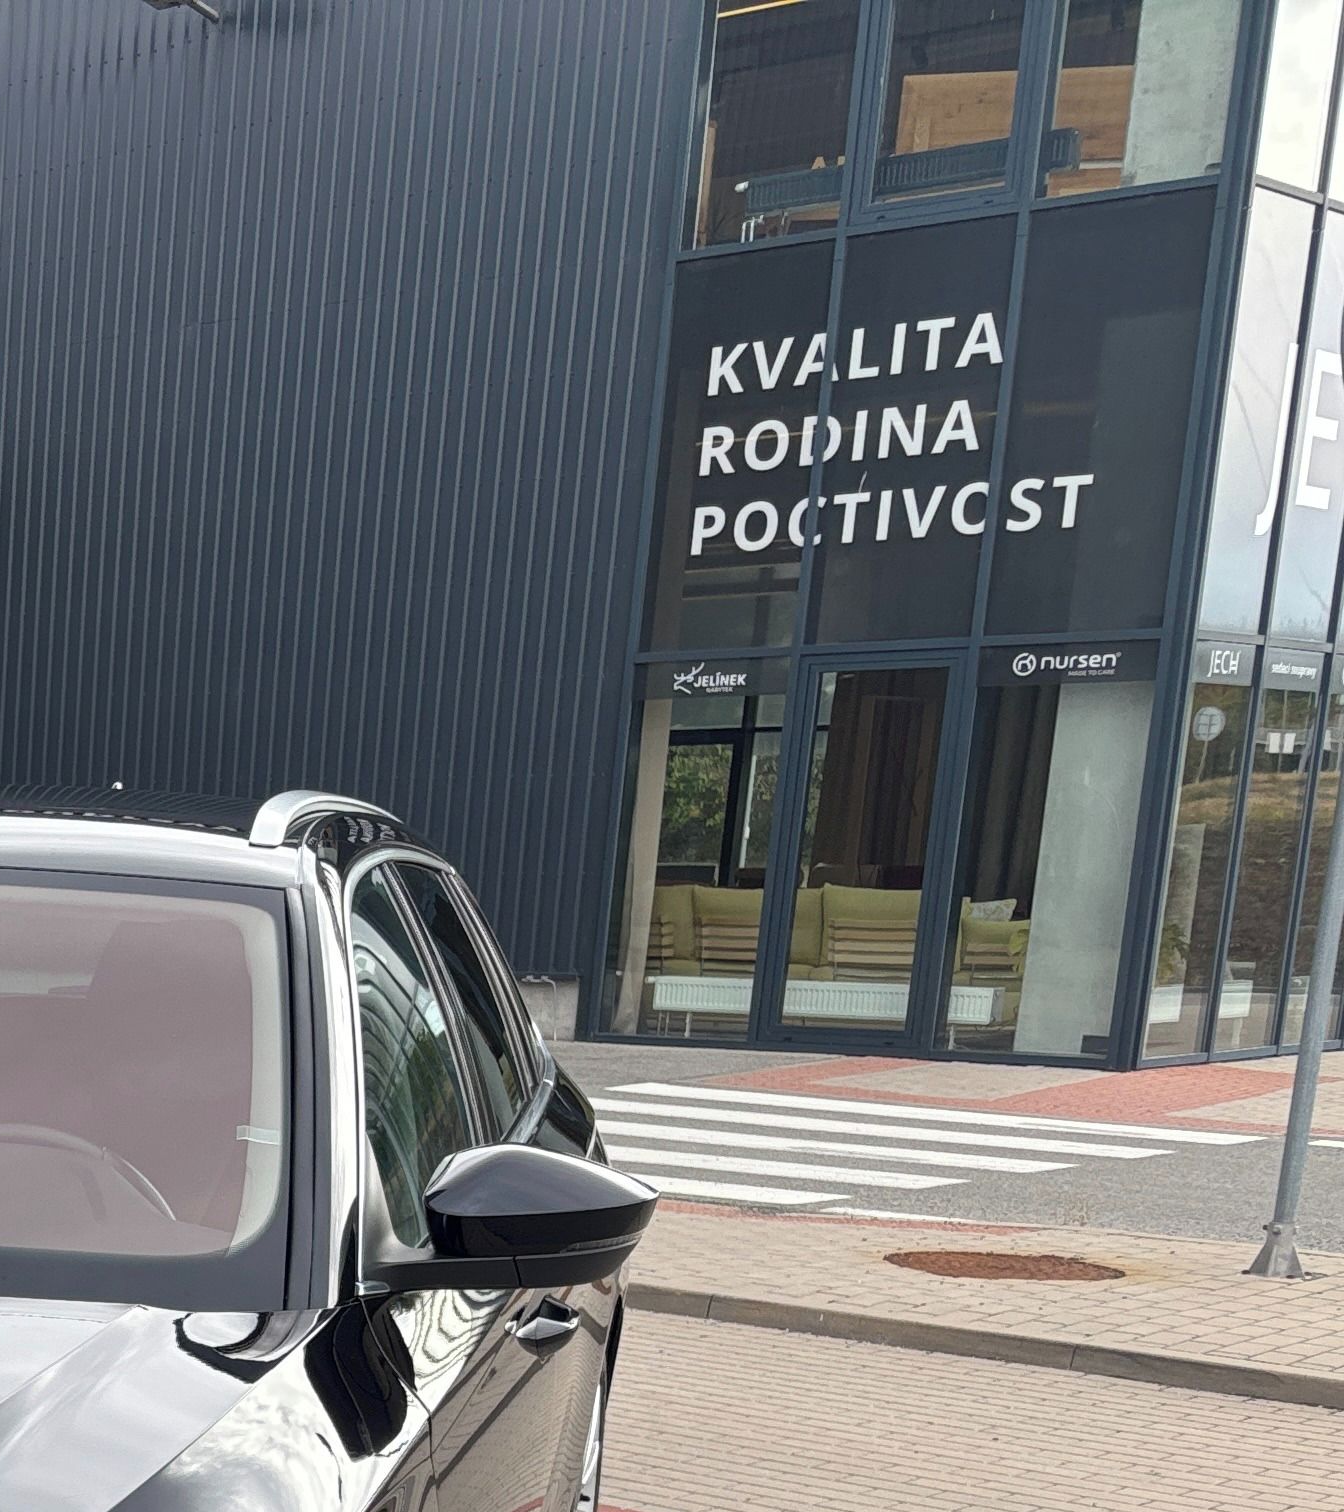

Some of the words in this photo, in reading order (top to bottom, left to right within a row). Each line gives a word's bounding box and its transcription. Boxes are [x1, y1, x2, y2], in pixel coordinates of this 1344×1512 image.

[706, 312, 1004, 397] KVALITA
[697, 400, 980, 477] RODINA
[689, 473, 1095, 556] POCTIVOST
[693, 671, 747, 688] JELÍNEK
[1206, 650, 1243, 678] JECH
